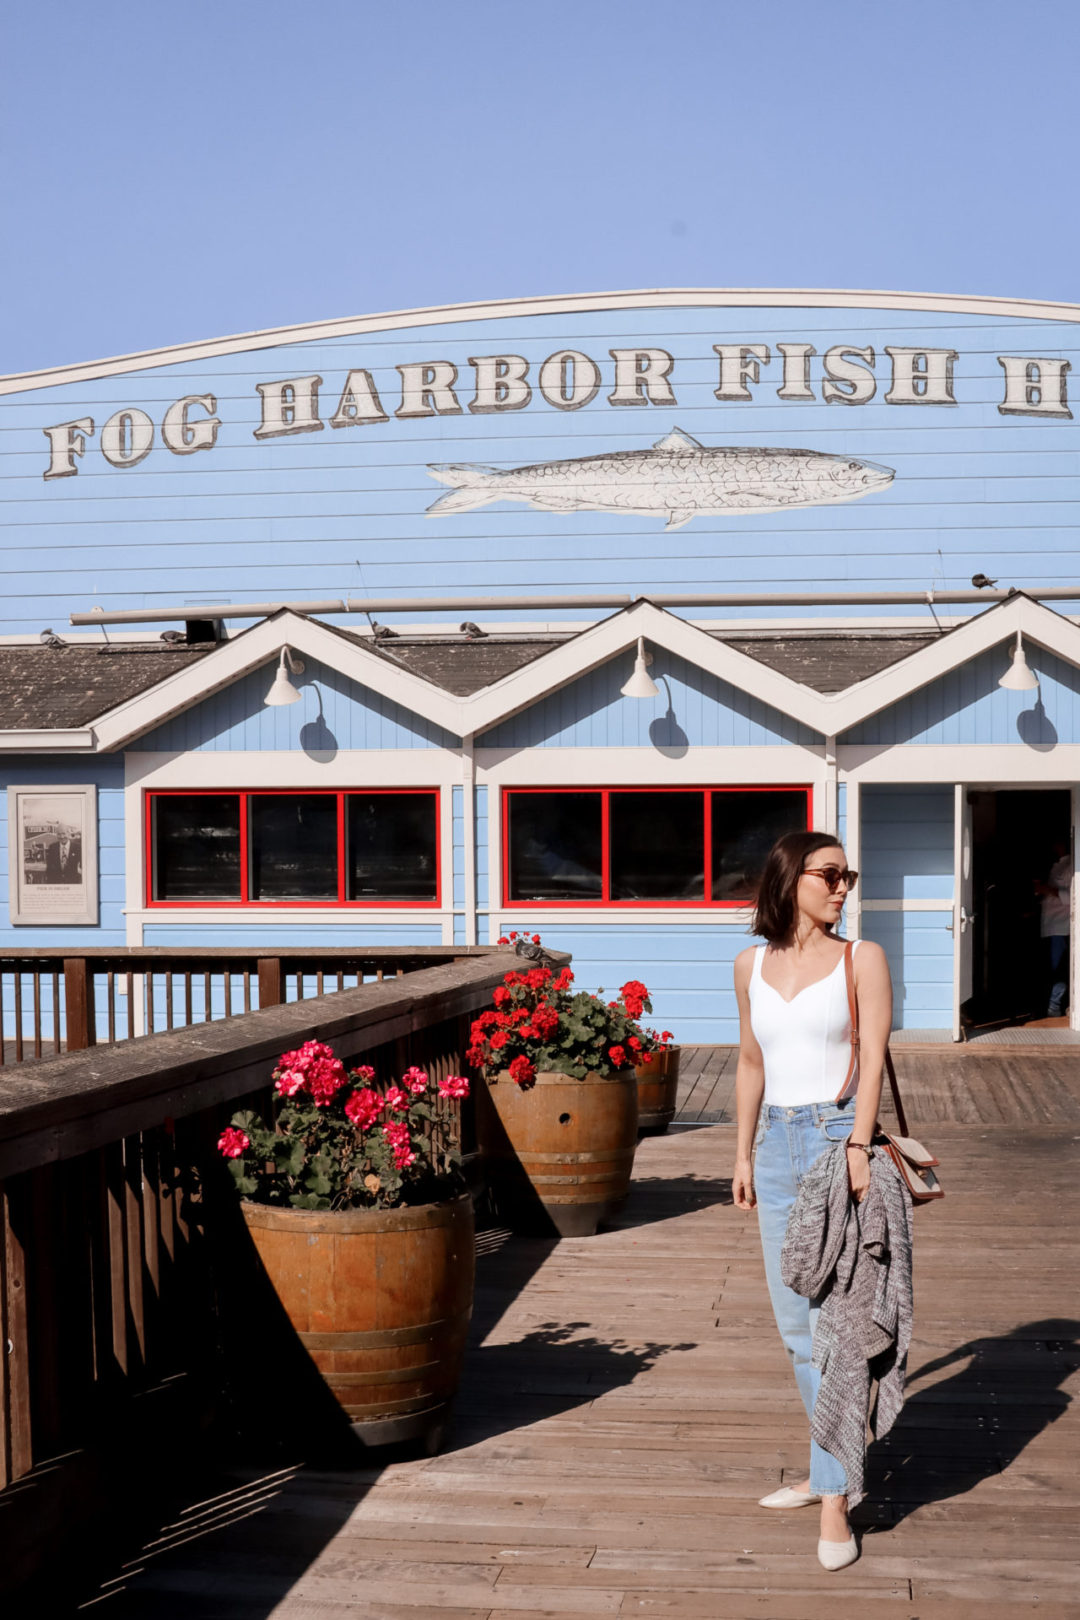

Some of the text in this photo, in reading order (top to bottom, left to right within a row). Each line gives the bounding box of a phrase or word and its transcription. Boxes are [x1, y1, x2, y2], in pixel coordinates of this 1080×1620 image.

[43, 393, 221, 481] FOG
[253, 348, 677, 440] HARBOR
[712, 343, 959, 407] FISH
